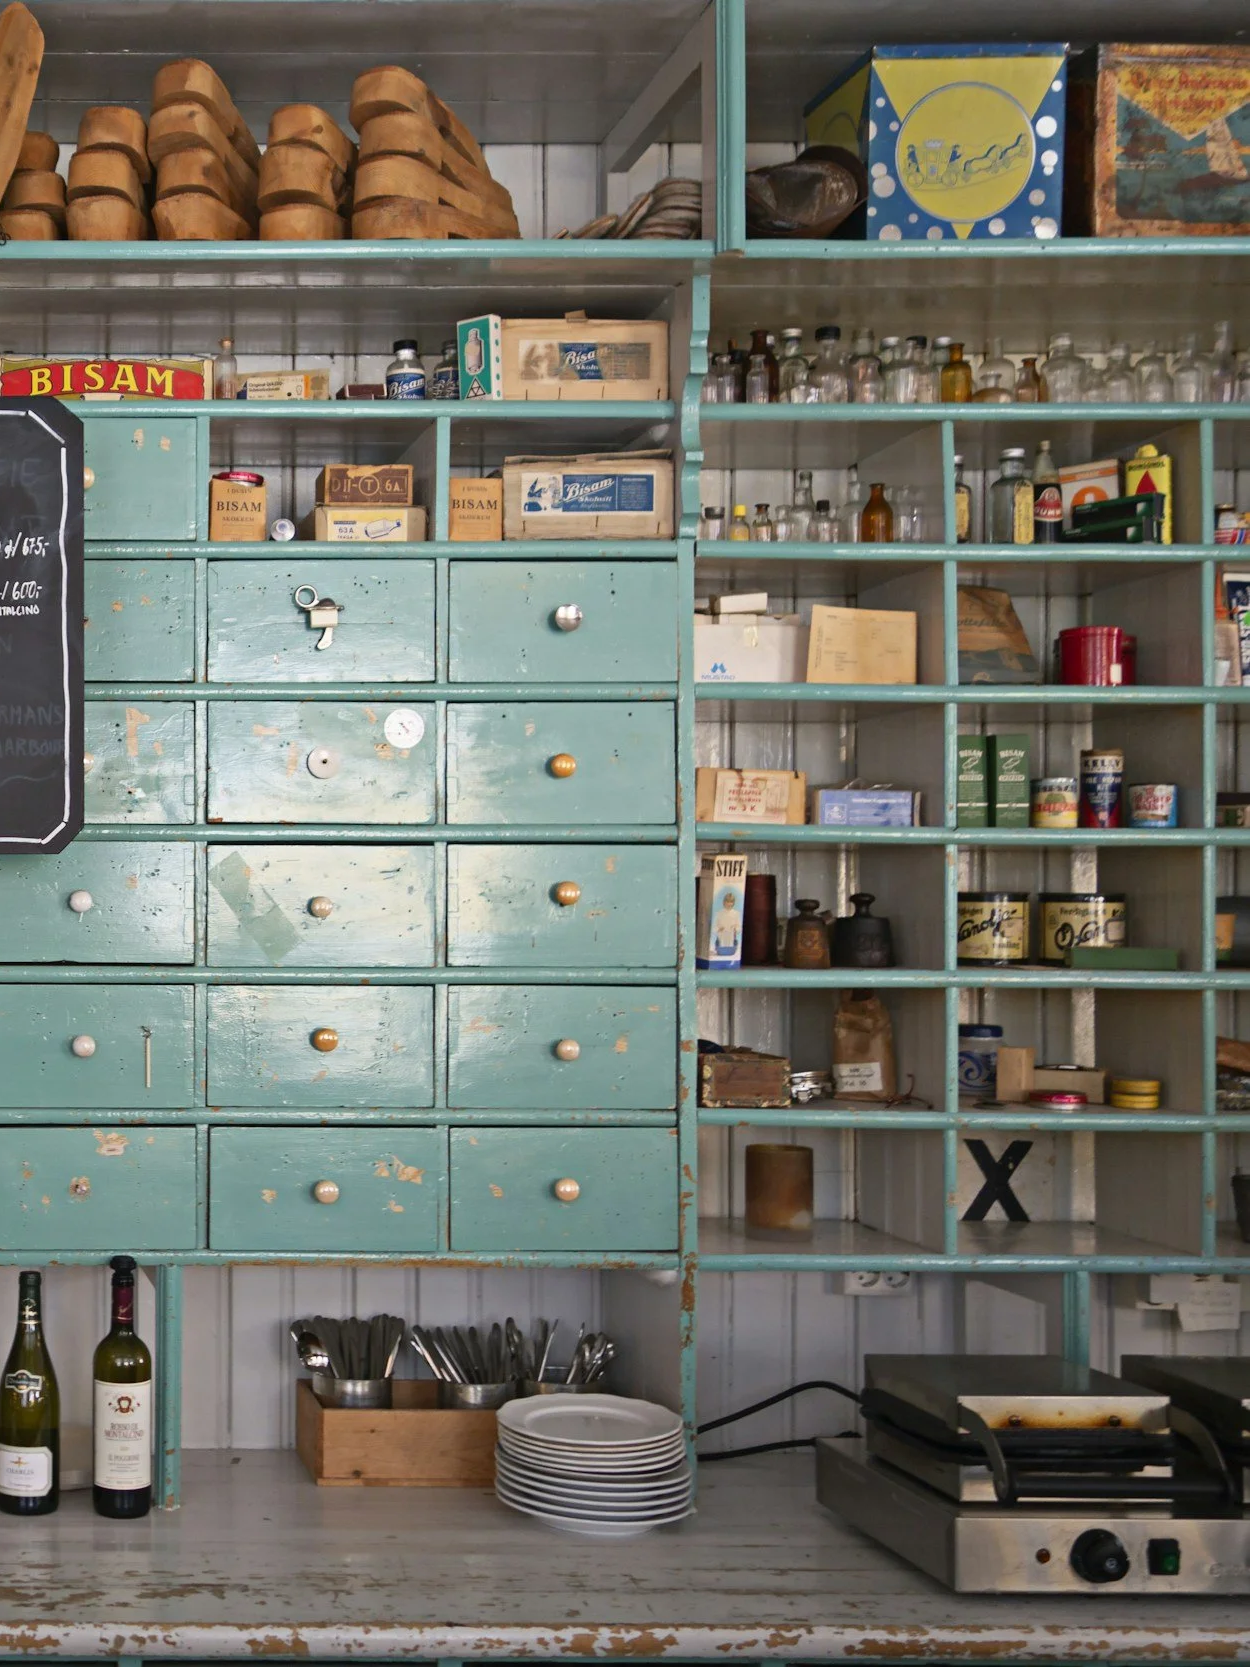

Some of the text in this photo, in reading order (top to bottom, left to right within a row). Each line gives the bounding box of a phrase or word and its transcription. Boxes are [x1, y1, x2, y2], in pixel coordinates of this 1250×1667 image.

[29, 363, 175, 398] BISAM
[565, 478, 615, 501] Bisam
[216, 501, 262, 512] BISAM
[452, 499, 498, 509] BISAM
[715, 859, 746, 877] STIFF
[962, 1139, 1034, 1223] X
